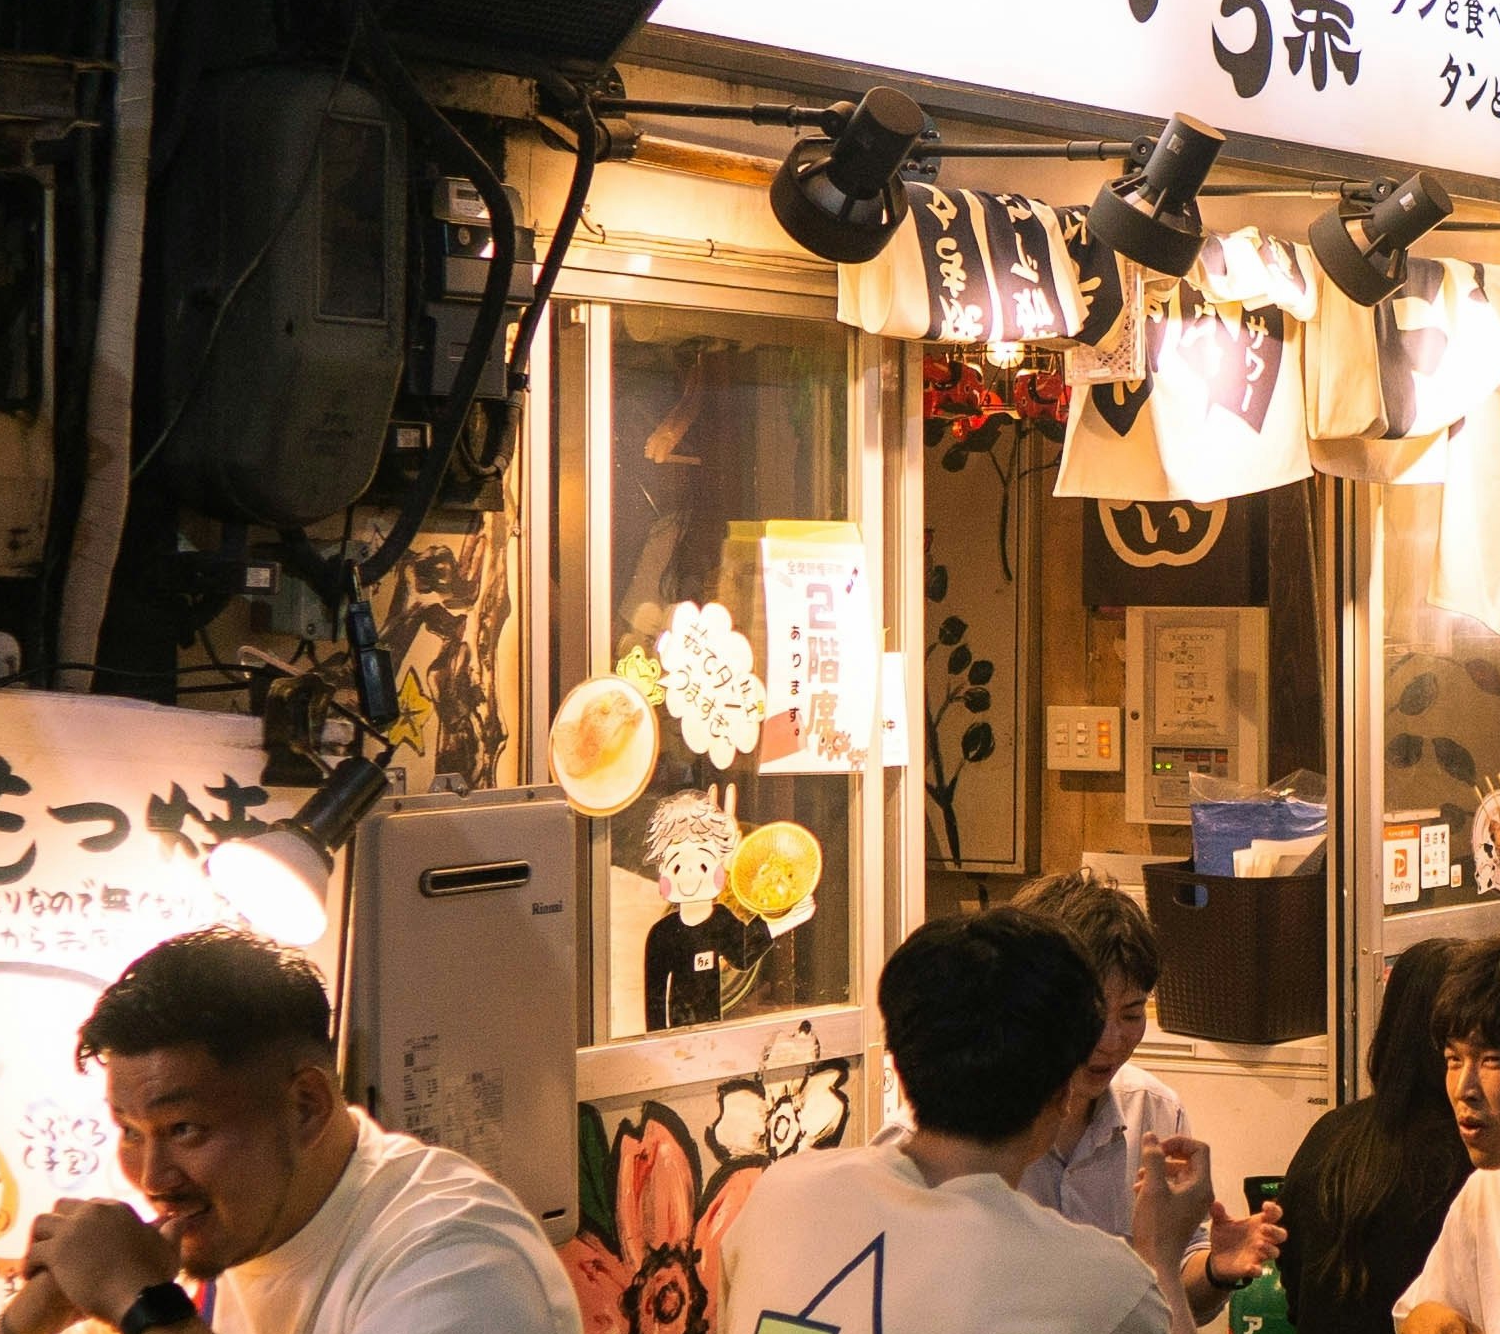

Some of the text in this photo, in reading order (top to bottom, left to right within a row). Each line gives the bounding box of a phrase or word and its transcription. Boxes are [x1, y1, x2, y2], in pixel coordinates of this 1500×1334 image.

[1240, 315, 1268, 412] サワー
[531, 900, 564, 915] Rinnai
